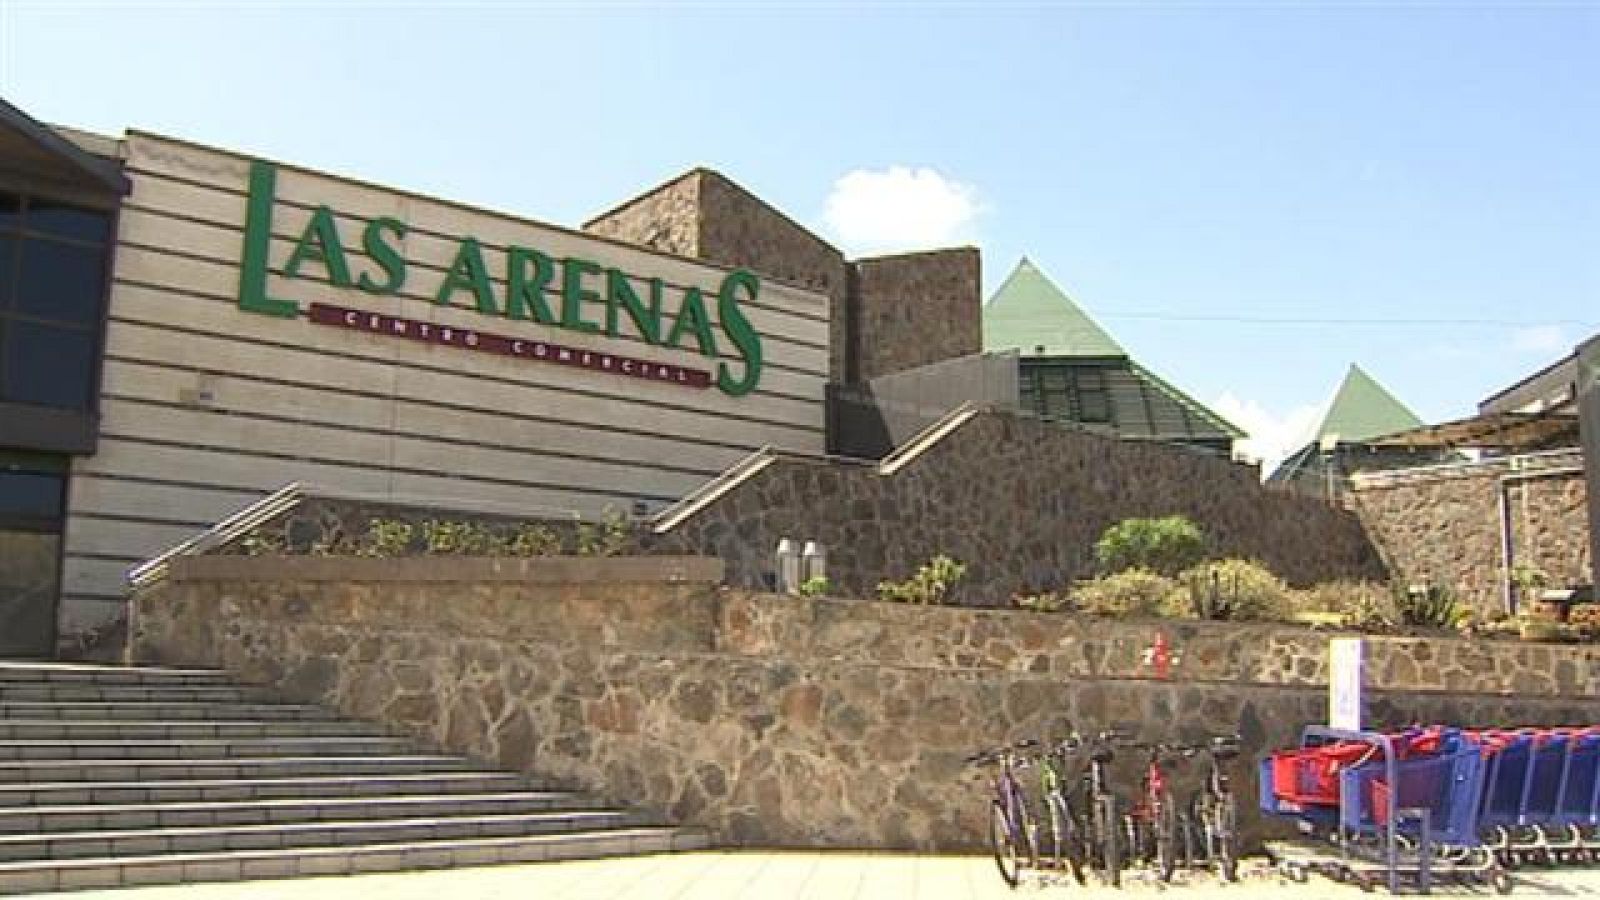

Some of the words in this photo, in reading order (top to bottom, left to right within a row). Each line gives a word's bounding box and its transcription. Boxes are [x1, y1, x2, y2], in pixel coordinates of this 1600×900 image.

[239, 160, 406, 318] LAS
[435, 235, 763, 396] ARENAS
[343, 310, 479, 347] CENTRO
[510, 340, 688, 382] COMERCIAL
